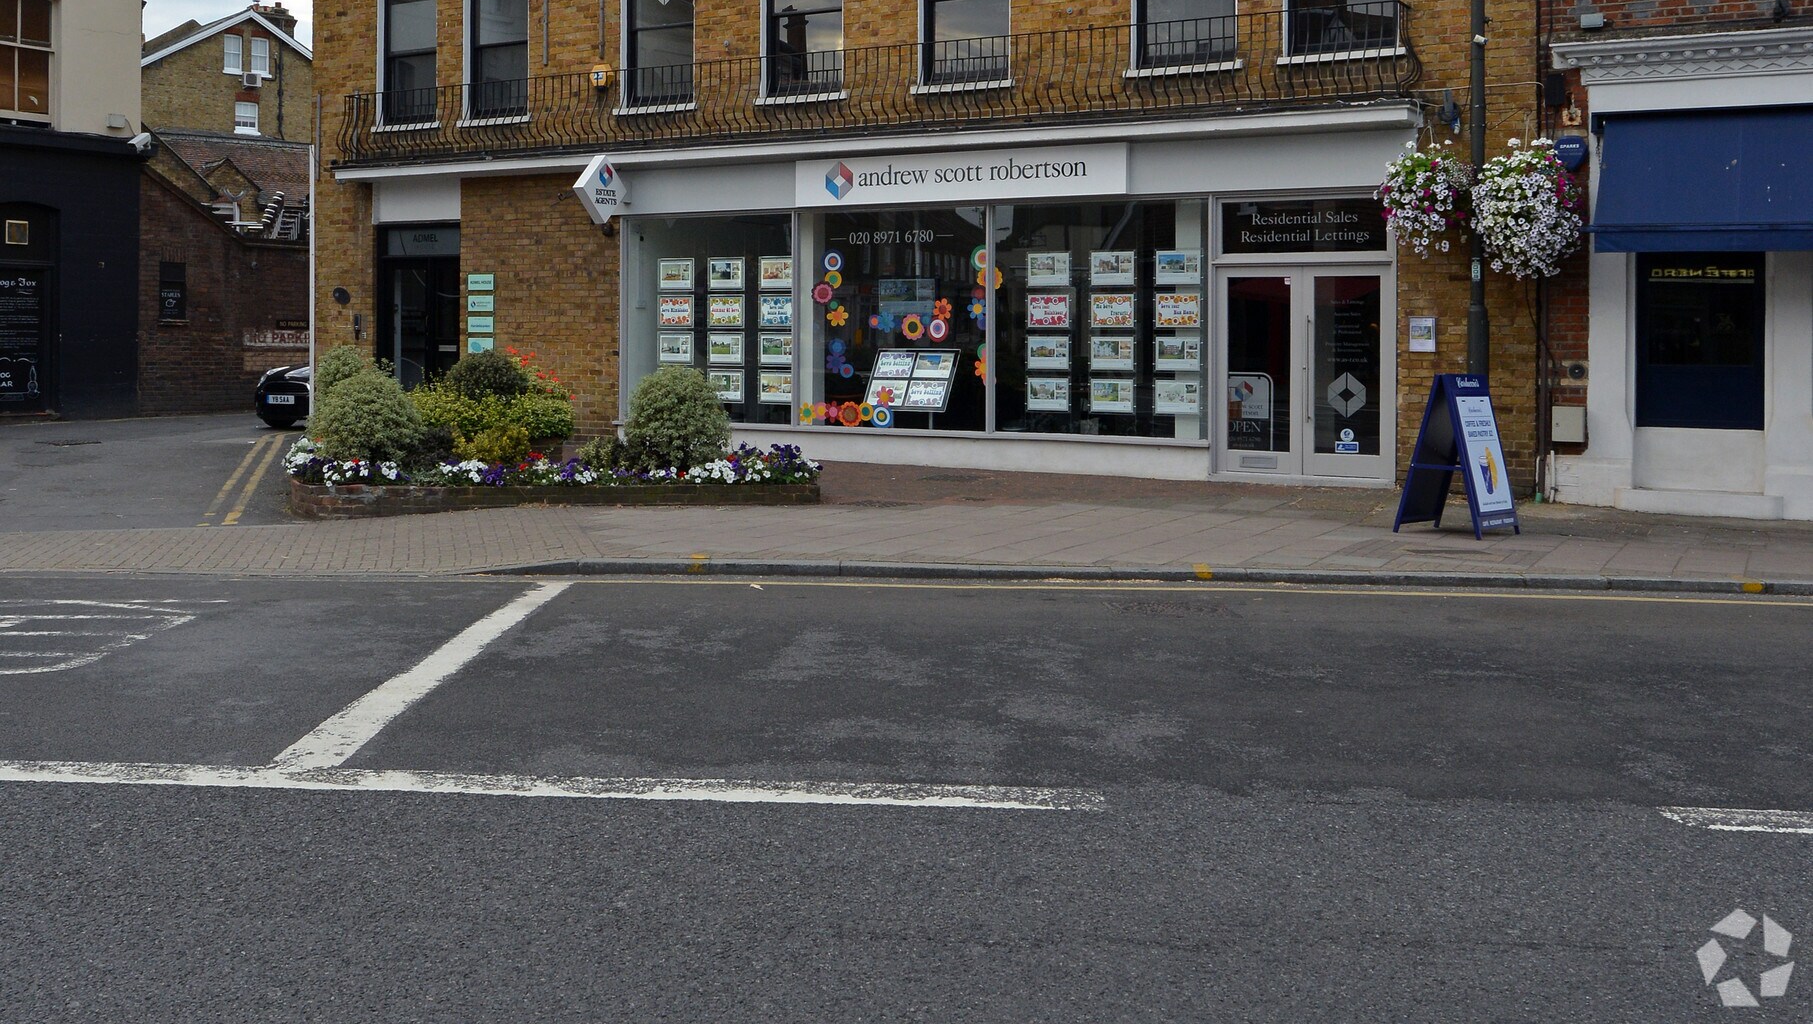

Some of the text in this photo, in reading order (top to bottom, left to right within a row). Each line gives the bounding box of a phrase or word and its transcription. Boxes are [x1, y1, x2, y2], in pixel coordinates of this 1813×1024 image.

[858, 157, 1087, 187] andrew scott robertson
[595, 188, 617, 197] ESTATE
[594, 196, 617, 206] AGENTS
[1251, 210, 1359, 226] Residential Sales
[412, 233, 439, 243] ADMEL
[849, 229, 934, 245] 020 8971 6780
[1240, 228, 1371, 244] Residential Lettings
